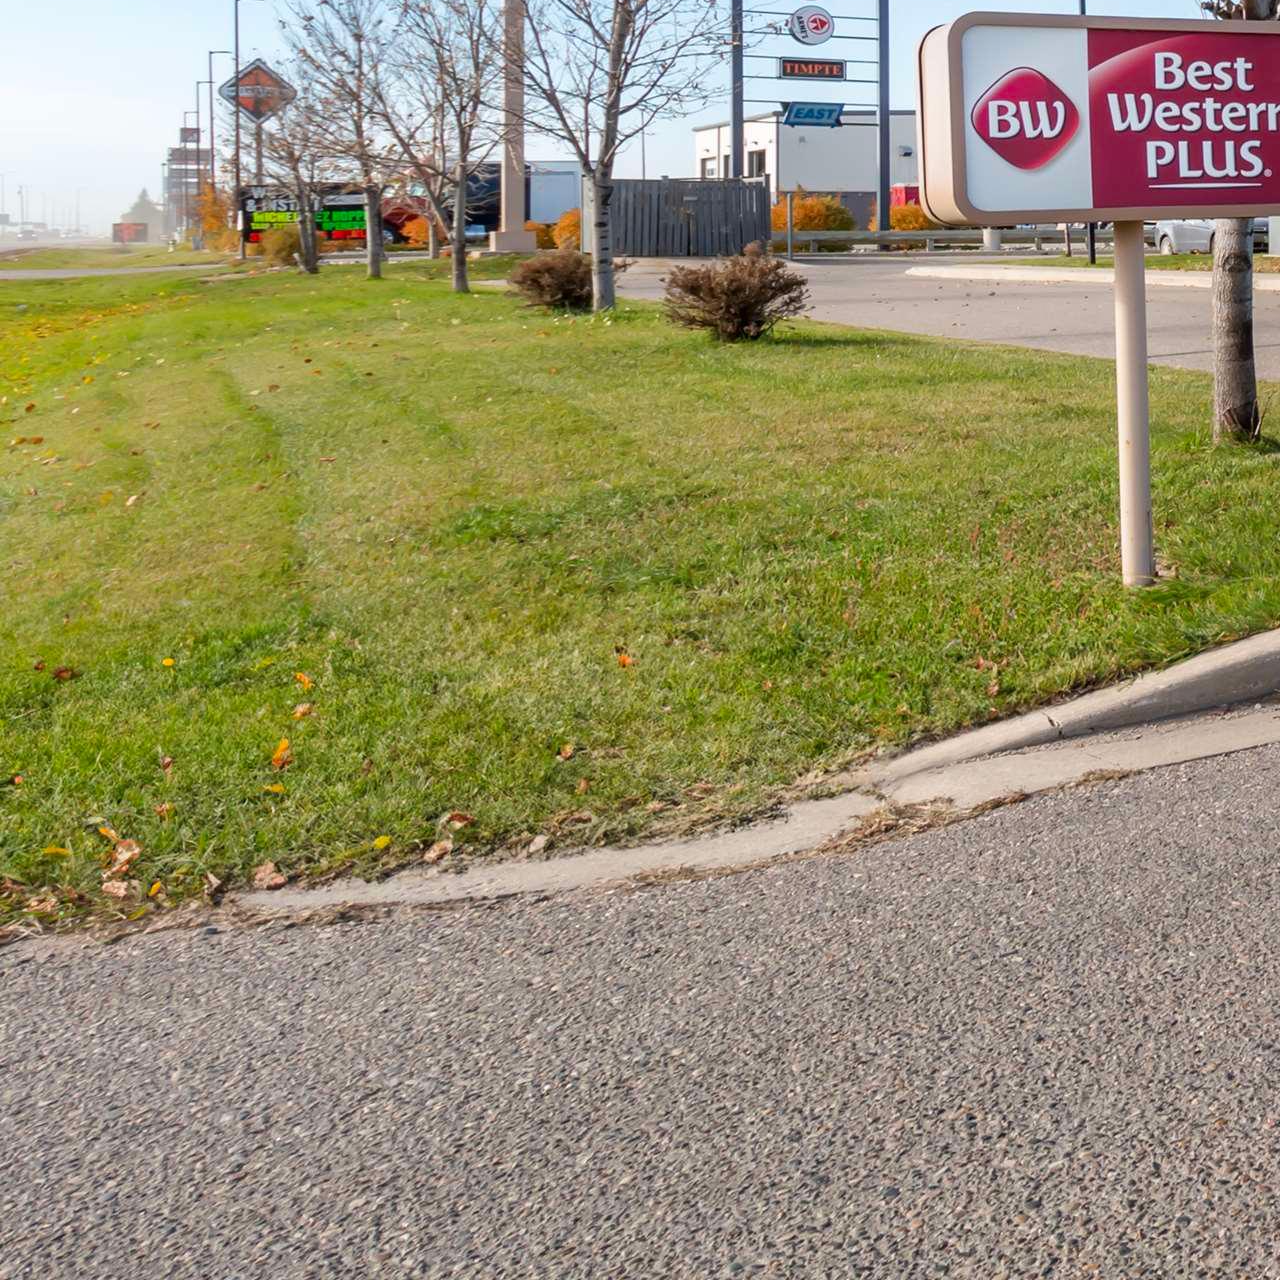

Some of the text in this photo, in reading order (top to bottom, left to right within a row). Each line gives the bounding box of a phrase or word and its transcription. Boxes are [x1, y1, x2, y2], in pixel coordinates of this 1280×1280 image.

[783, 62, 842, 76] TIMPTE
[1154, 52, 1255, 92] Best
[793, 107, 836, 120] EAST
[988, 100, 1065, 139] BW
